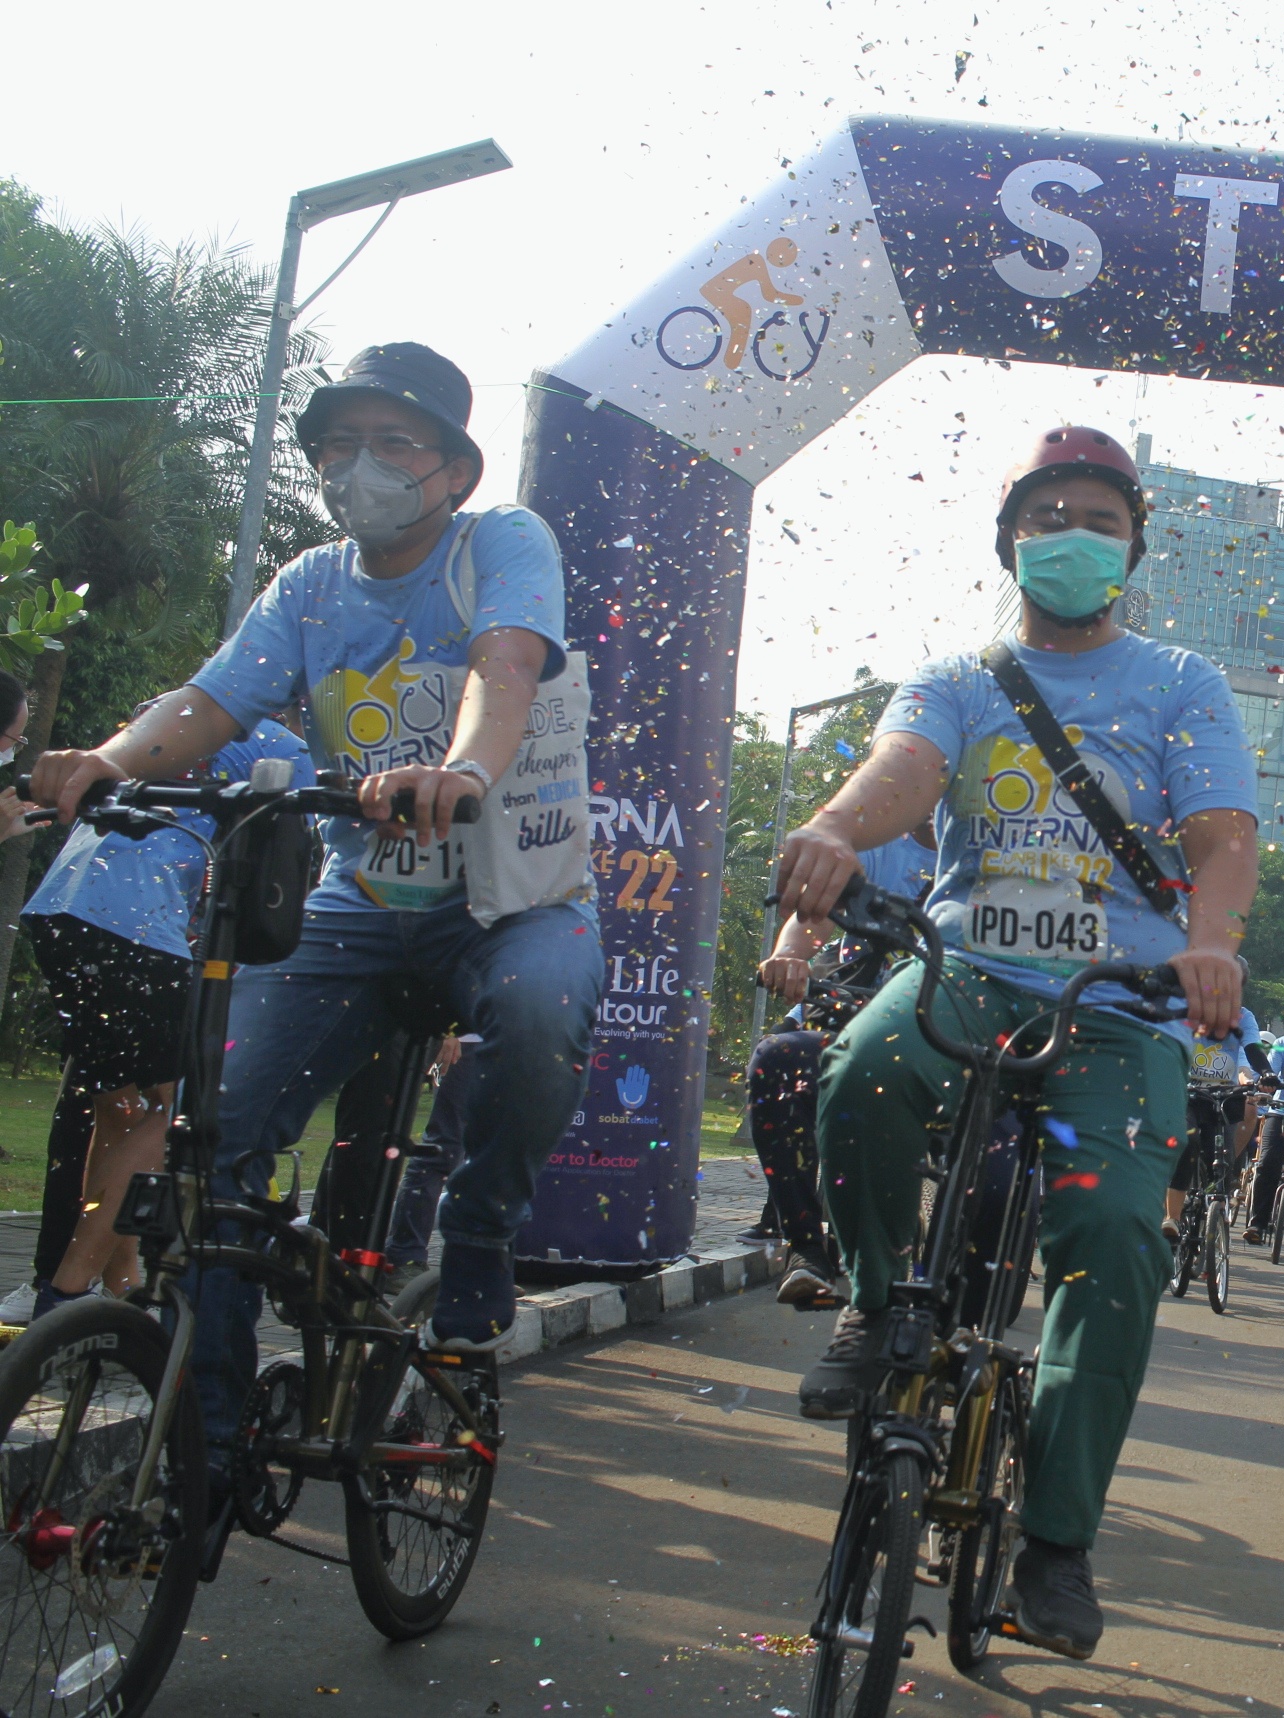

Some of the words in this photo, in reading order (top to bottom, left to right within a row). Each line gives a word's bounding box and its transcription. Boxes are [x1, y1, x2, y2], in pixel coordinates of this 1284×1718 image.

[502, 791, 537, 809] than
[518, 808, 577, 852] bills
[616, 849, 678, 911] 22
[971, 903, 1099, 953] IPD-043
[609, 954, 680, 996] Life
[594, 1027, 632, 1040] Evolving
[633, 1028, 650, 1039] with
[651, 1030, 666, 1041] you
[569, 1152, 585, 1166] to
[589, 1153, 640, 1168] Doctor
